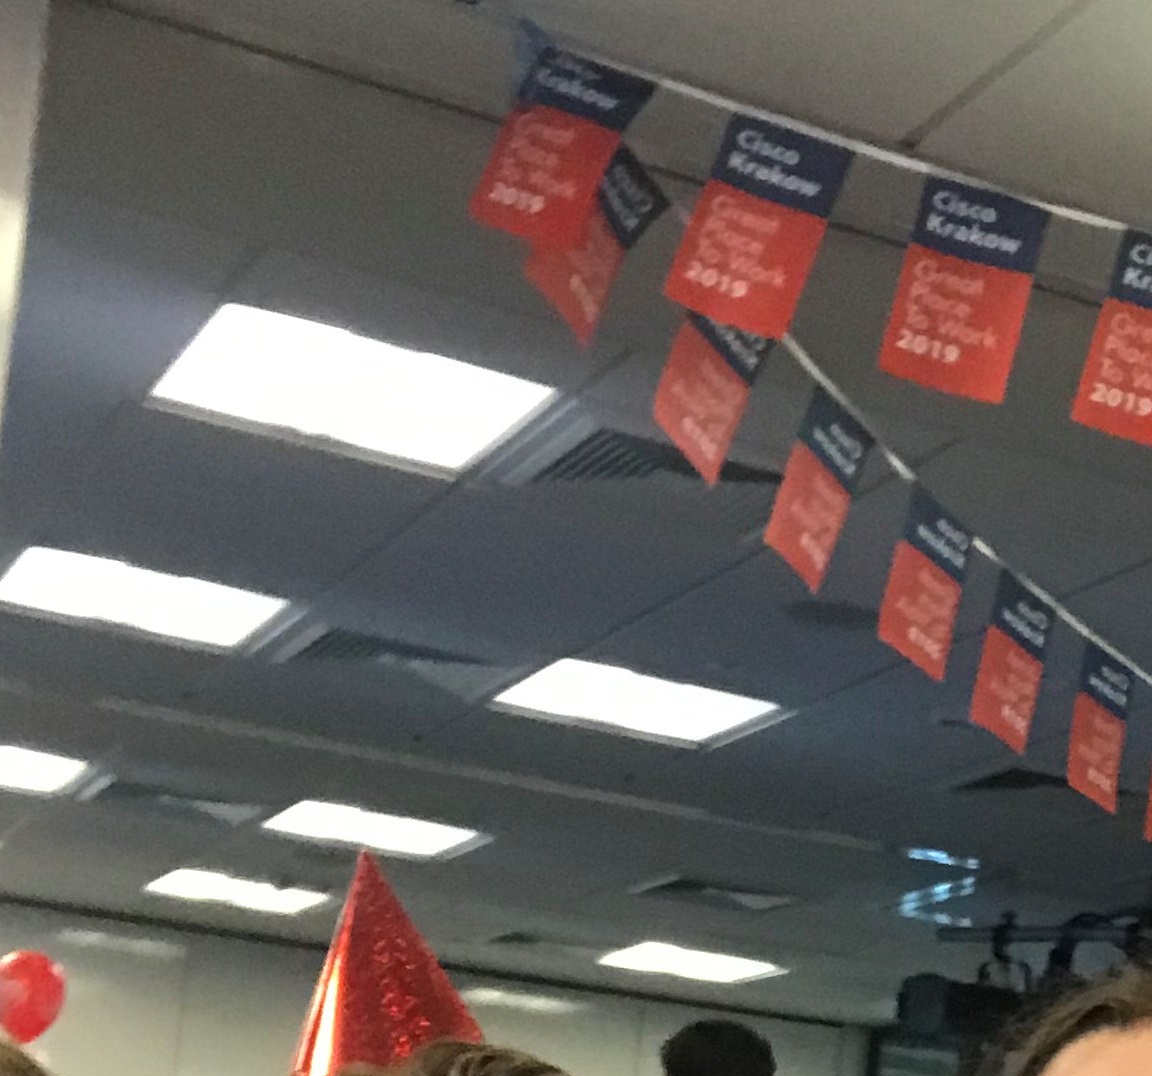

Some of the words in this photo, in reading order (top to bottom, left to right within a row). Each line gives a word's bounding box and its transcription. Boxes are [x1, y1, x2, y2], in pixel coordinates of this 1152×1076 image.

[736, 128, 801, 167] Cisco
[727, 150, 823, 197] Krakow
[932, 191, 998, 224] Cisco
[926, 212, 1023, 255] Krakow
[685, 260, 749, 298] 2019
[894, 328, 962, 364] 2019
